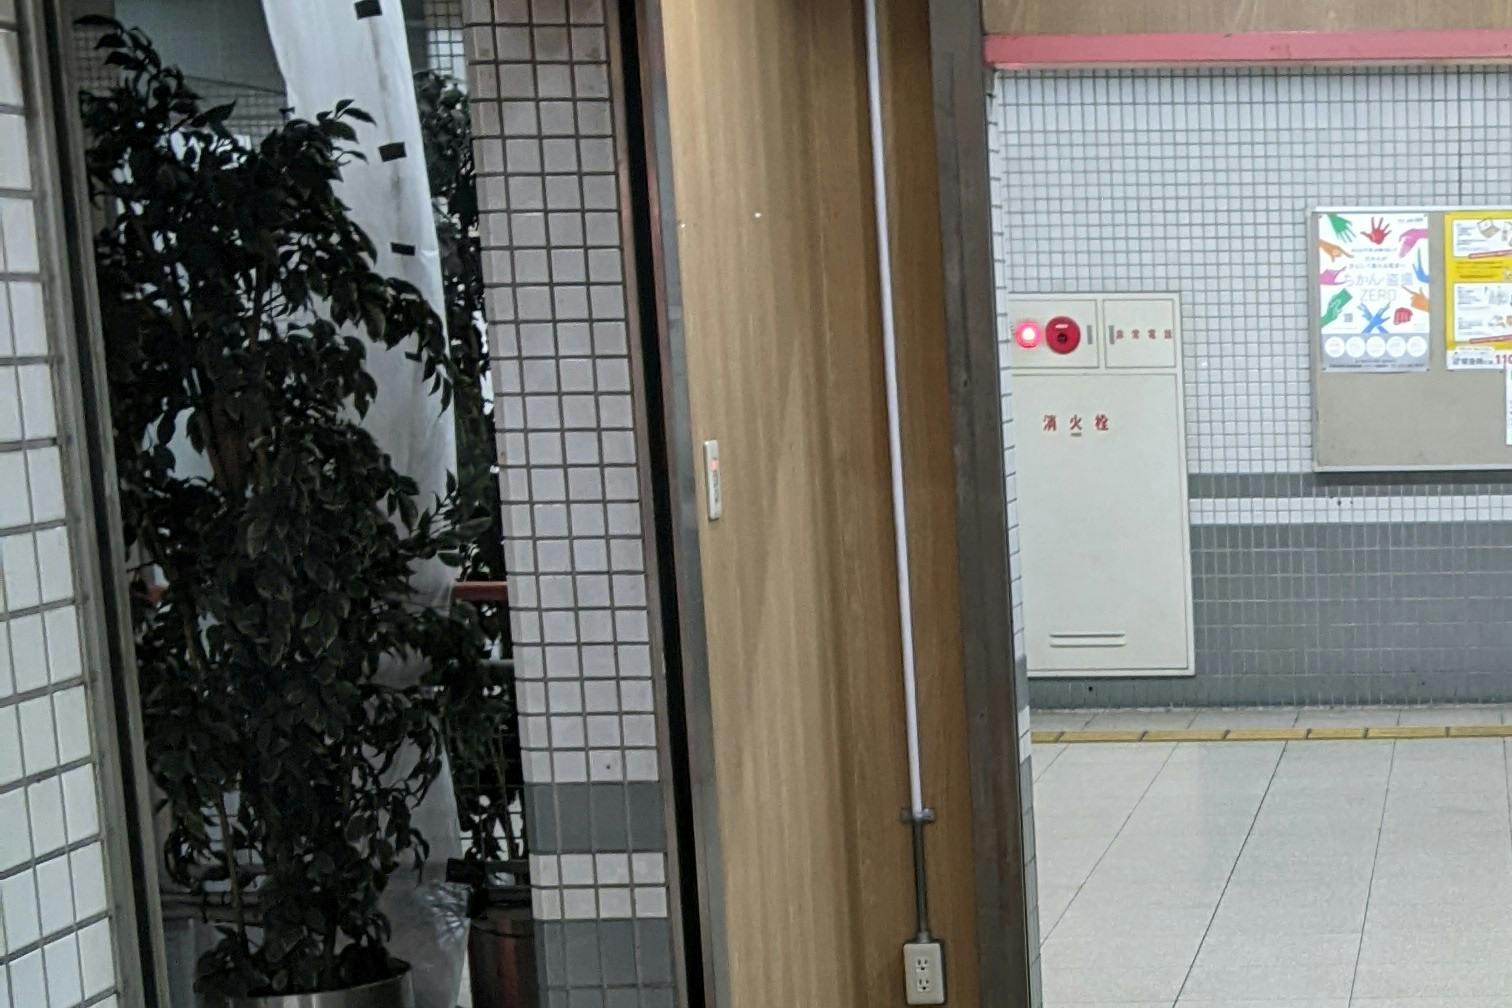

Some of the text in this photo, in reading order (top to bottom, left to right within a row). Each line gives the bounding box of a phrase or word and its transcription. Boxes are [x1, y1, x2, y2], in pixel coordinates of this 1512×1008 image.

[1360, 288, 1397, 302] ZERO
[1043, 414, 1109, 432] 消火栓
